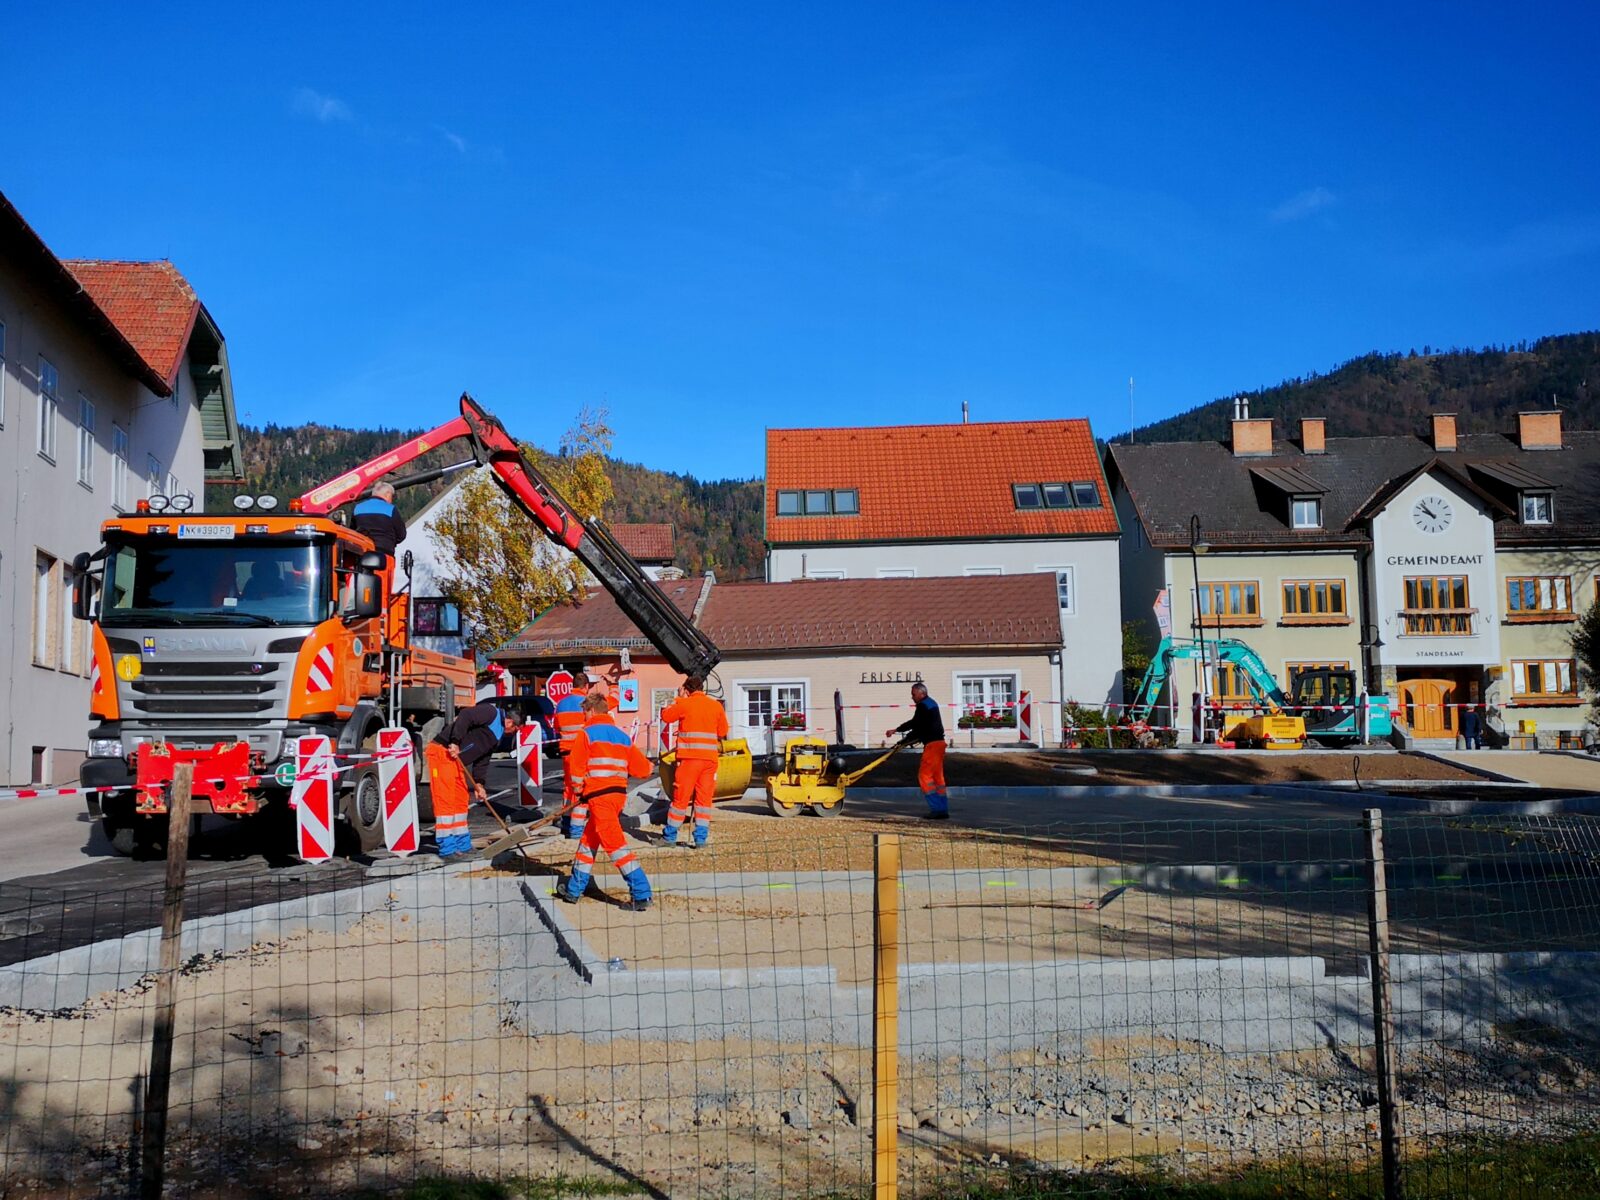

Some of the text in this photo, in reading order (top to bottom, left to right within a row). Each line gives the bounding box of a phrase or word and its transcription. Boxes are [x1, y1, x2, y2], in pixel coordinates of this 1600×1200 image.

[1387, 554, 1484, 566] GEMEINDEAMT
[160, 638, 248, 652] SCANIA
[861, 671, 922, 682] FRISEUR
[549, 682, 574, 696] STOP
